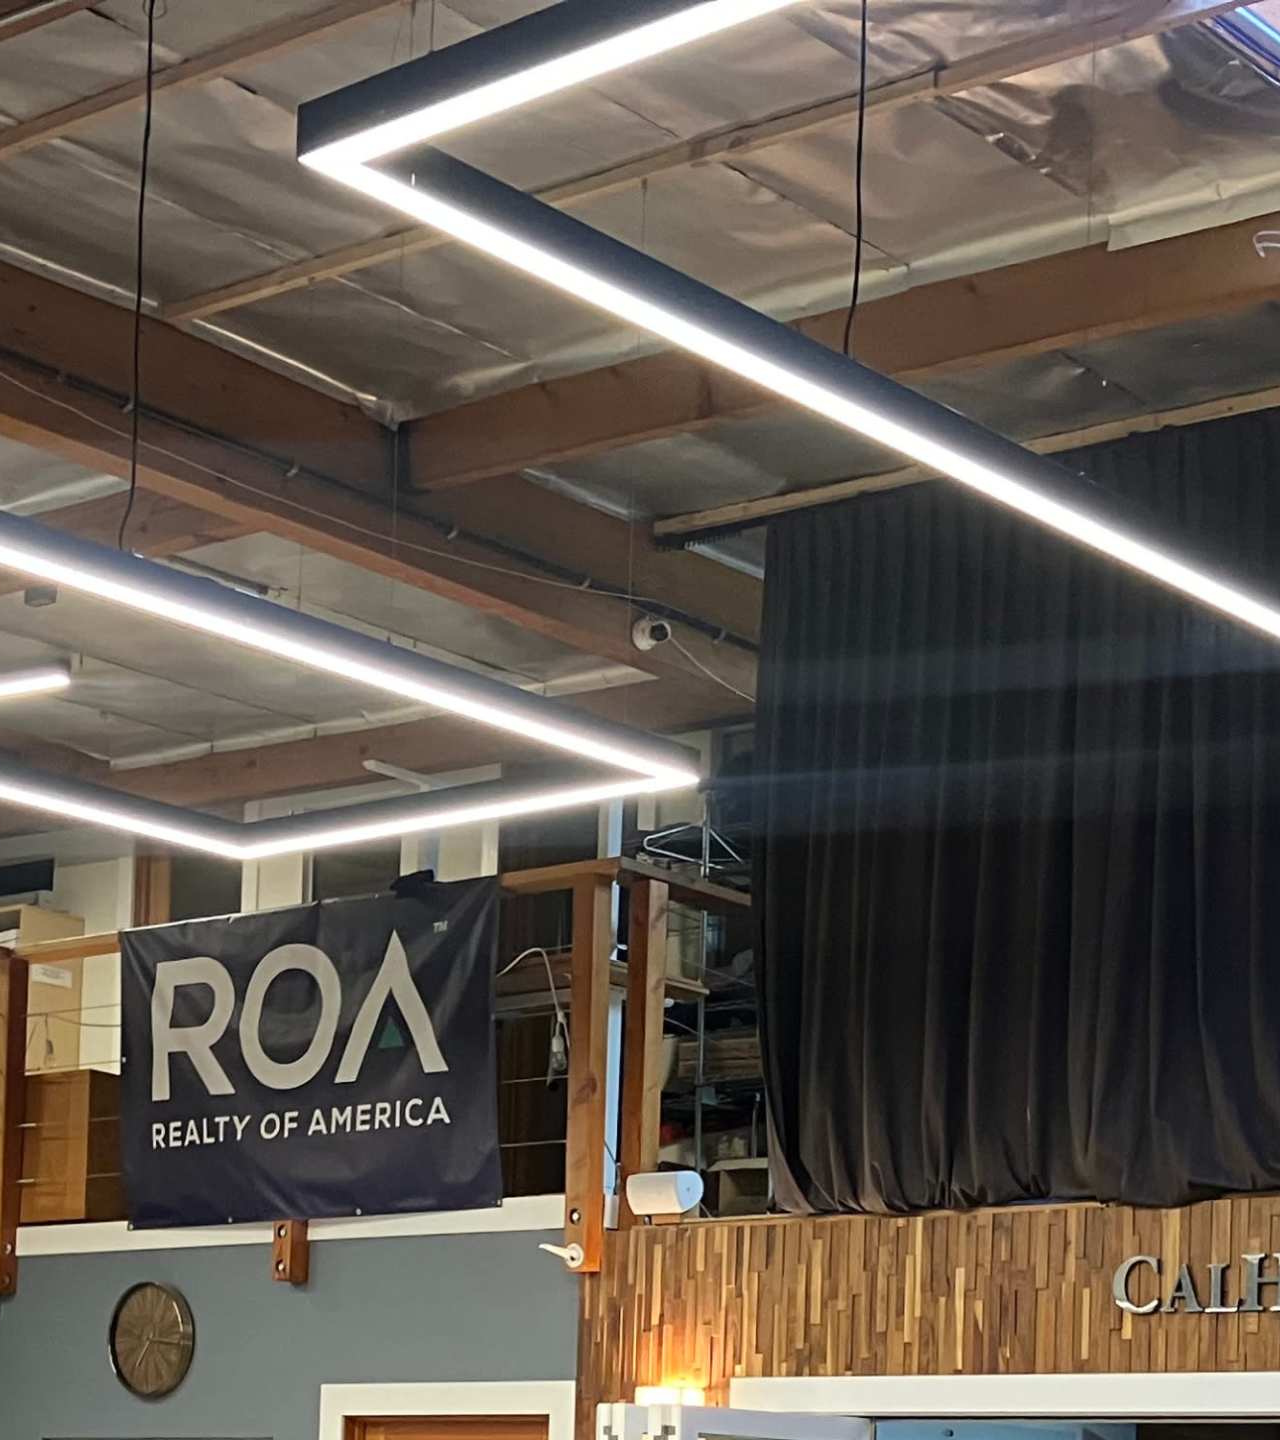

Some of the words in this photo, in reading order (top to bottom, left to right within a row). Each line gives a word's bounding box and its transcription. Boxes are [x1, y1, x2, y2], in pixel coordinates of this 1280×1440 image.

[151, 930, 449, 1101] ROA
[152, 1115, 251, 1149] REALTY
[260, 1111, 299, 1139] OF
[308, 1097, 451, 1136] AMERICA
